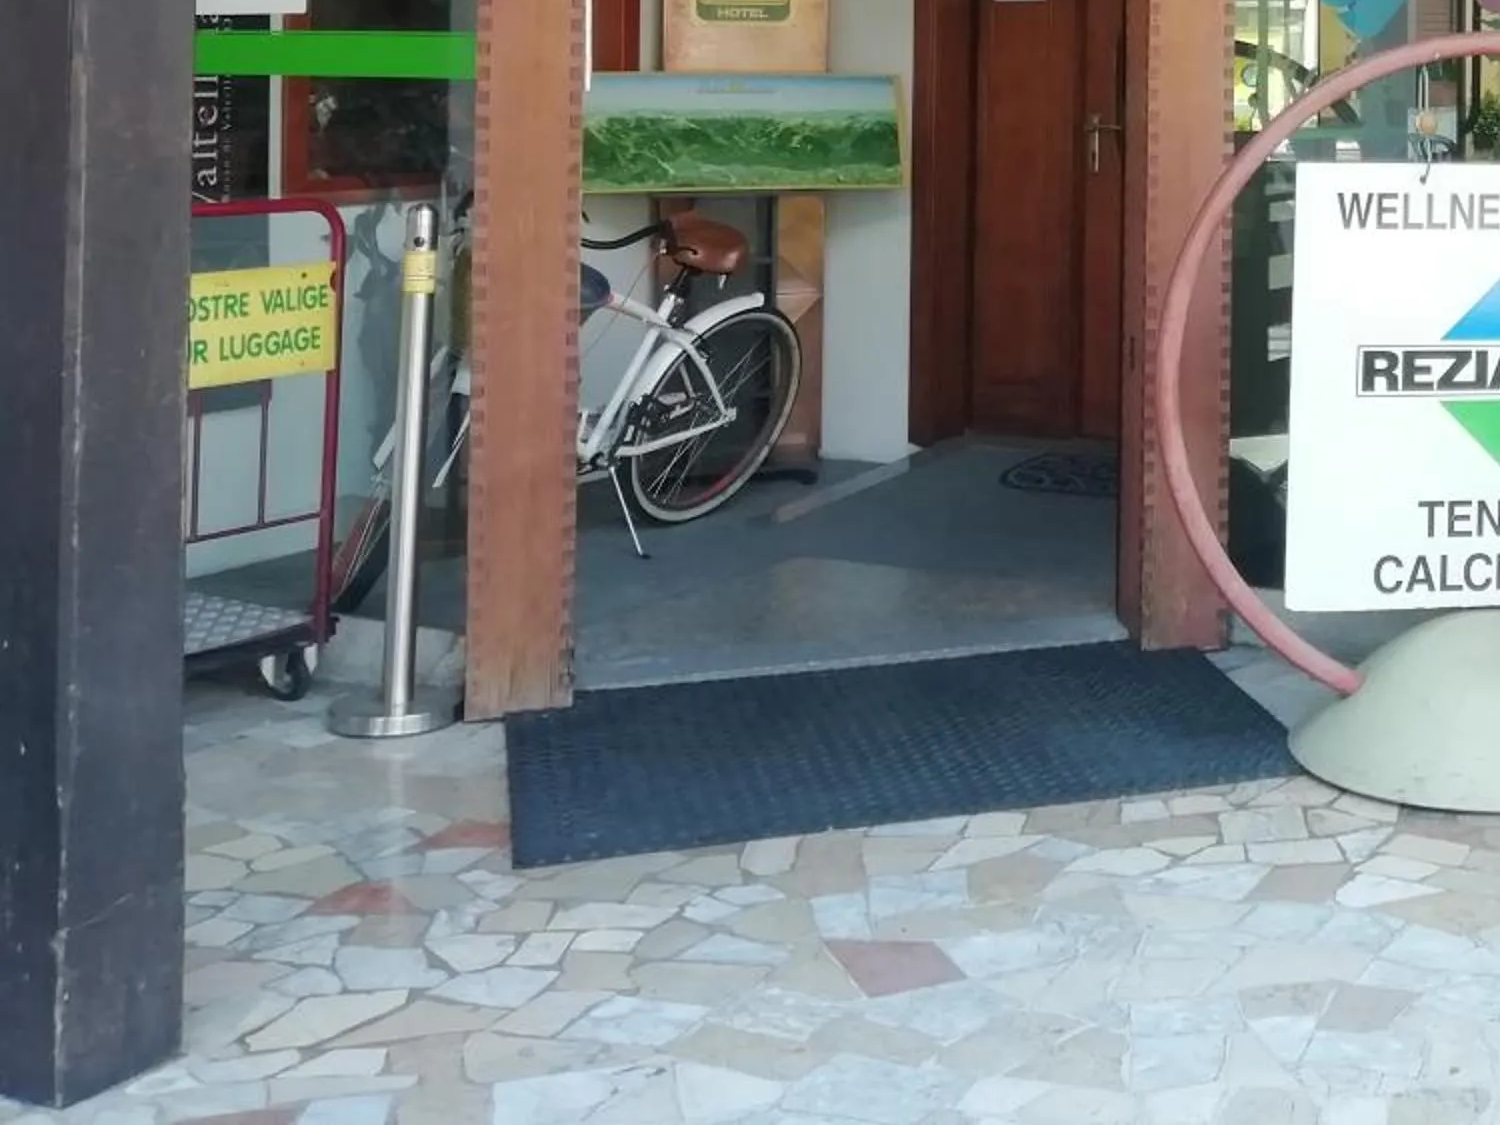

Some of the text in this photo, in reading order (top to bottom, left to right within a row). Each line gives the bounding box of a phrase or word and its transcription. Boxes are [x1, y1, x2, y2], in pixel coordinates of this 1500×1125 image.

[717, 7, 769, 19] HOTEL
[188, 284, 328, 322] OSTRE VALIGE
[219, 326, 321, 362] LUGGAGE
